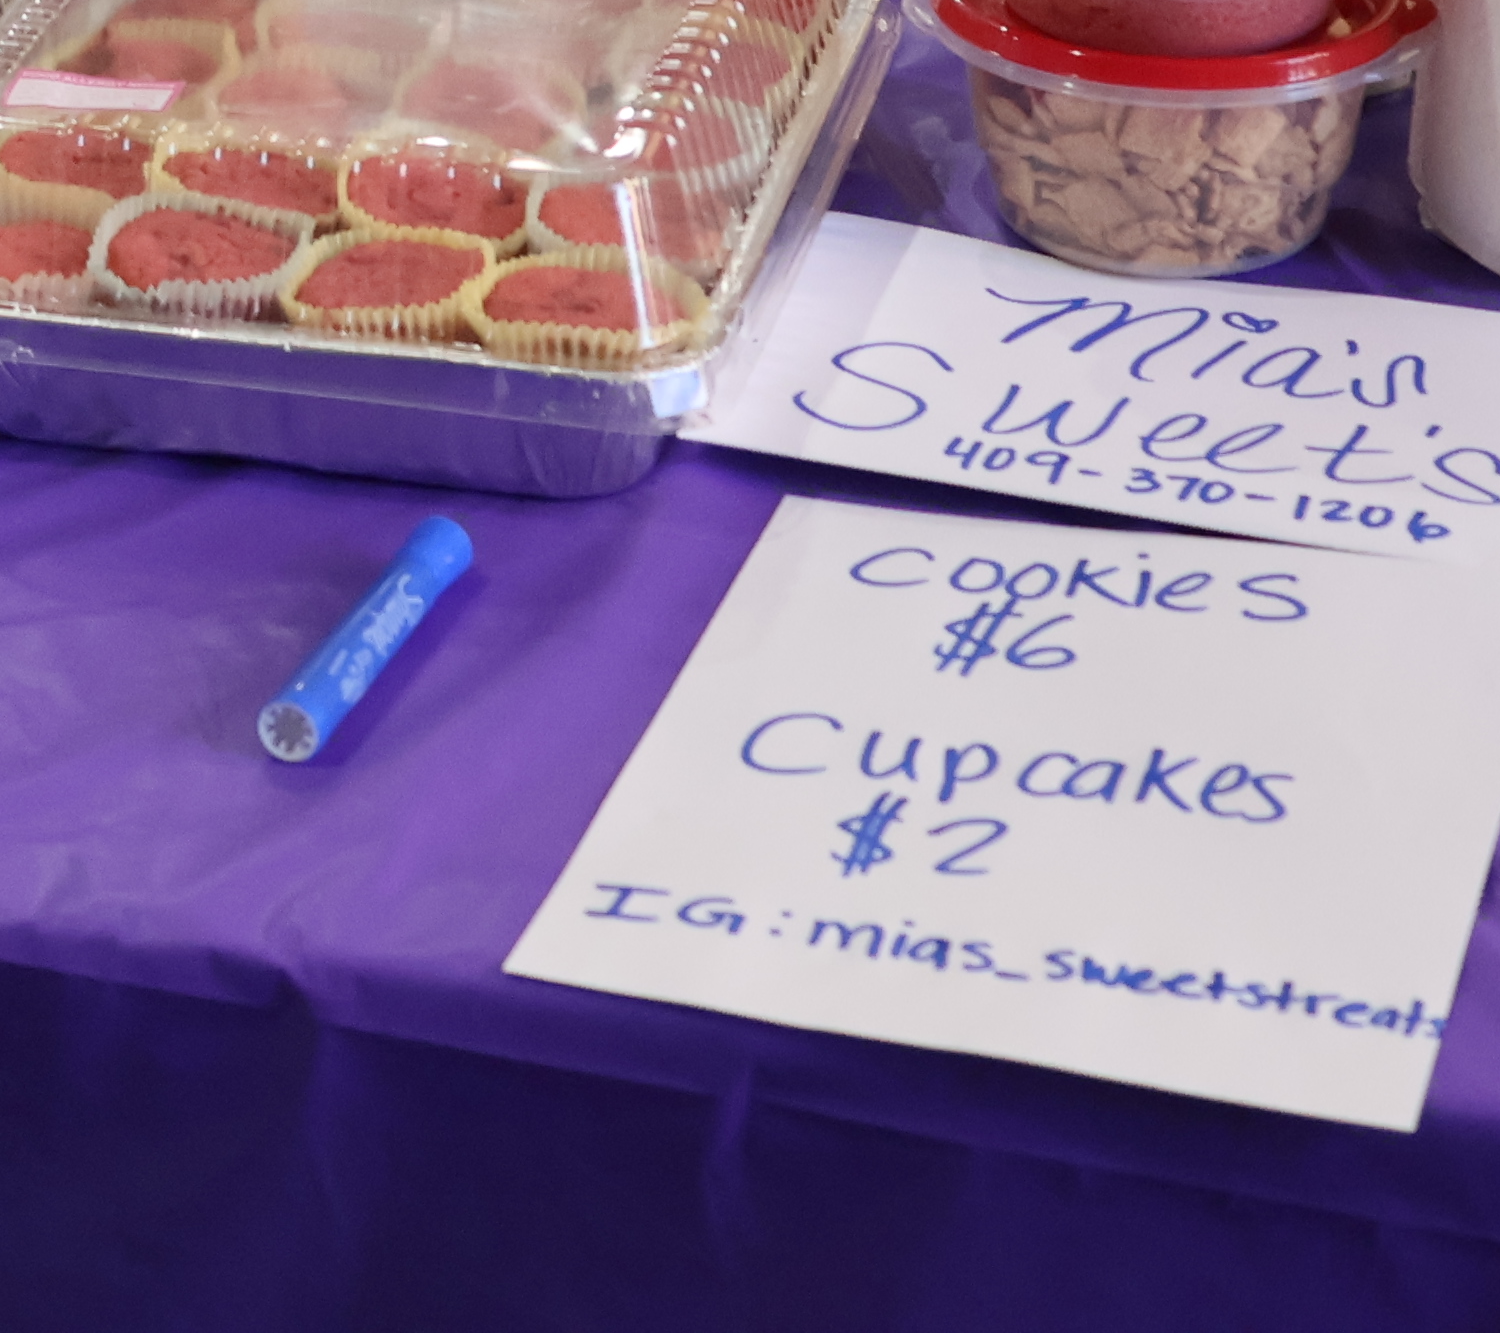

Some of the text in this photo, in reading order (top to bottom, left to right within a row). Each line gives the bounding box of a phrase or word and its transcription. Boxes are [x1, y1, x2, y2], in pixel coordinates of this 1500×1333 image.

[984, 285, 1427, 407] Mia's
[943, 435, 1451, 542] 409-370-1206
[932, 597, 1077, 677] $6
[738, 711, 1297, 825] Cupcakes
